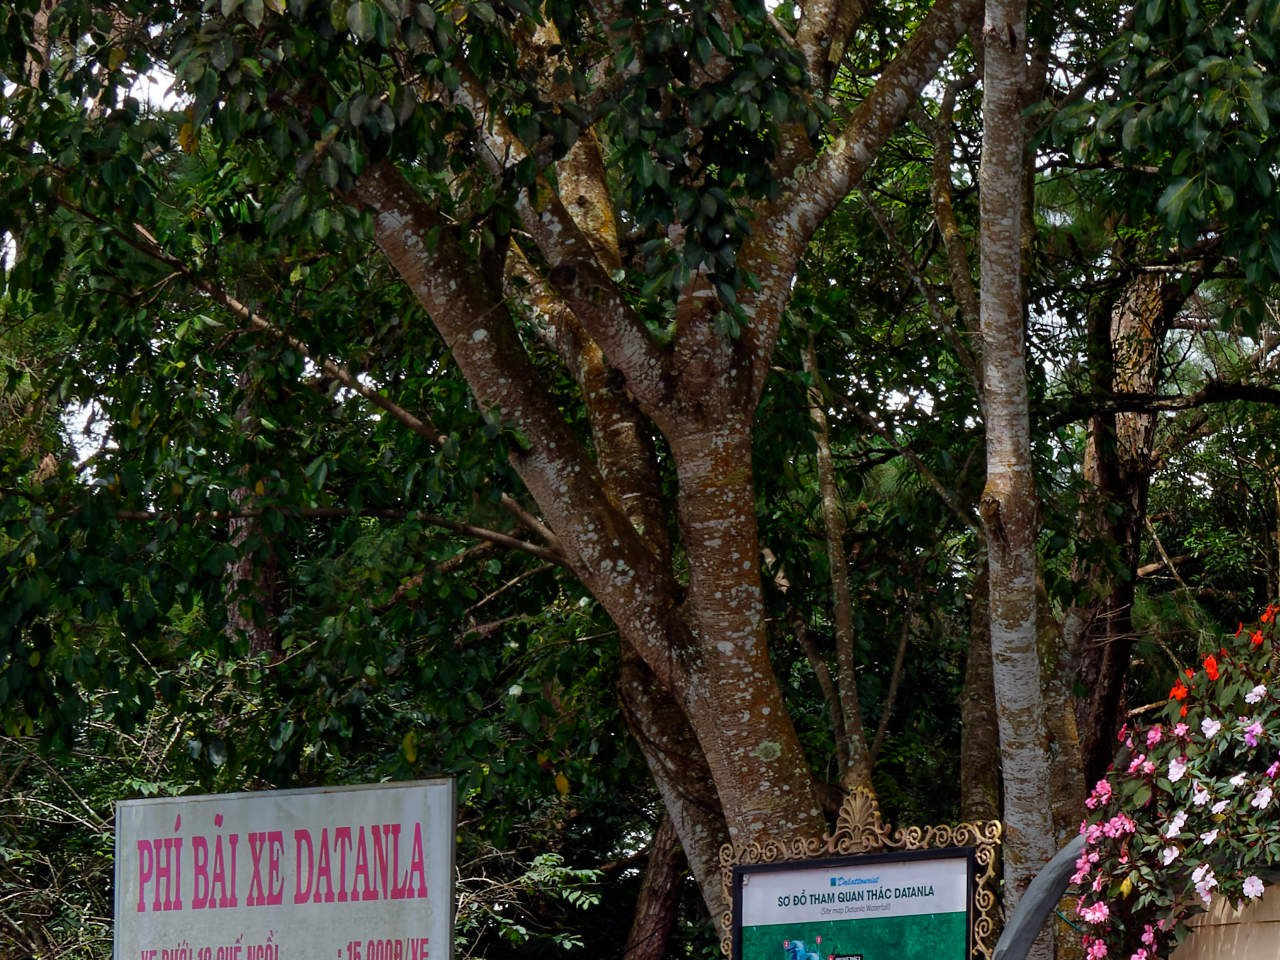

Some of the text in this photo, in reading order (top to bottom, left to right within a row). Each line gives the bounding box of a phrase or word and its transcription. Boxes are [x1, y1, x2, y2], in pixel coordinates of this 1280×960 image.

[137, 813, 428, 913] PHÍ BÃI XE DATANLA
[777, 893, 791, 908] SƠ
[809, 892, 835, 906] THAM
[838, 890, 864, 903] QUAN
[866, 886, 892, 901] THÁC
[894, 884, 935, 899] DATANLA
